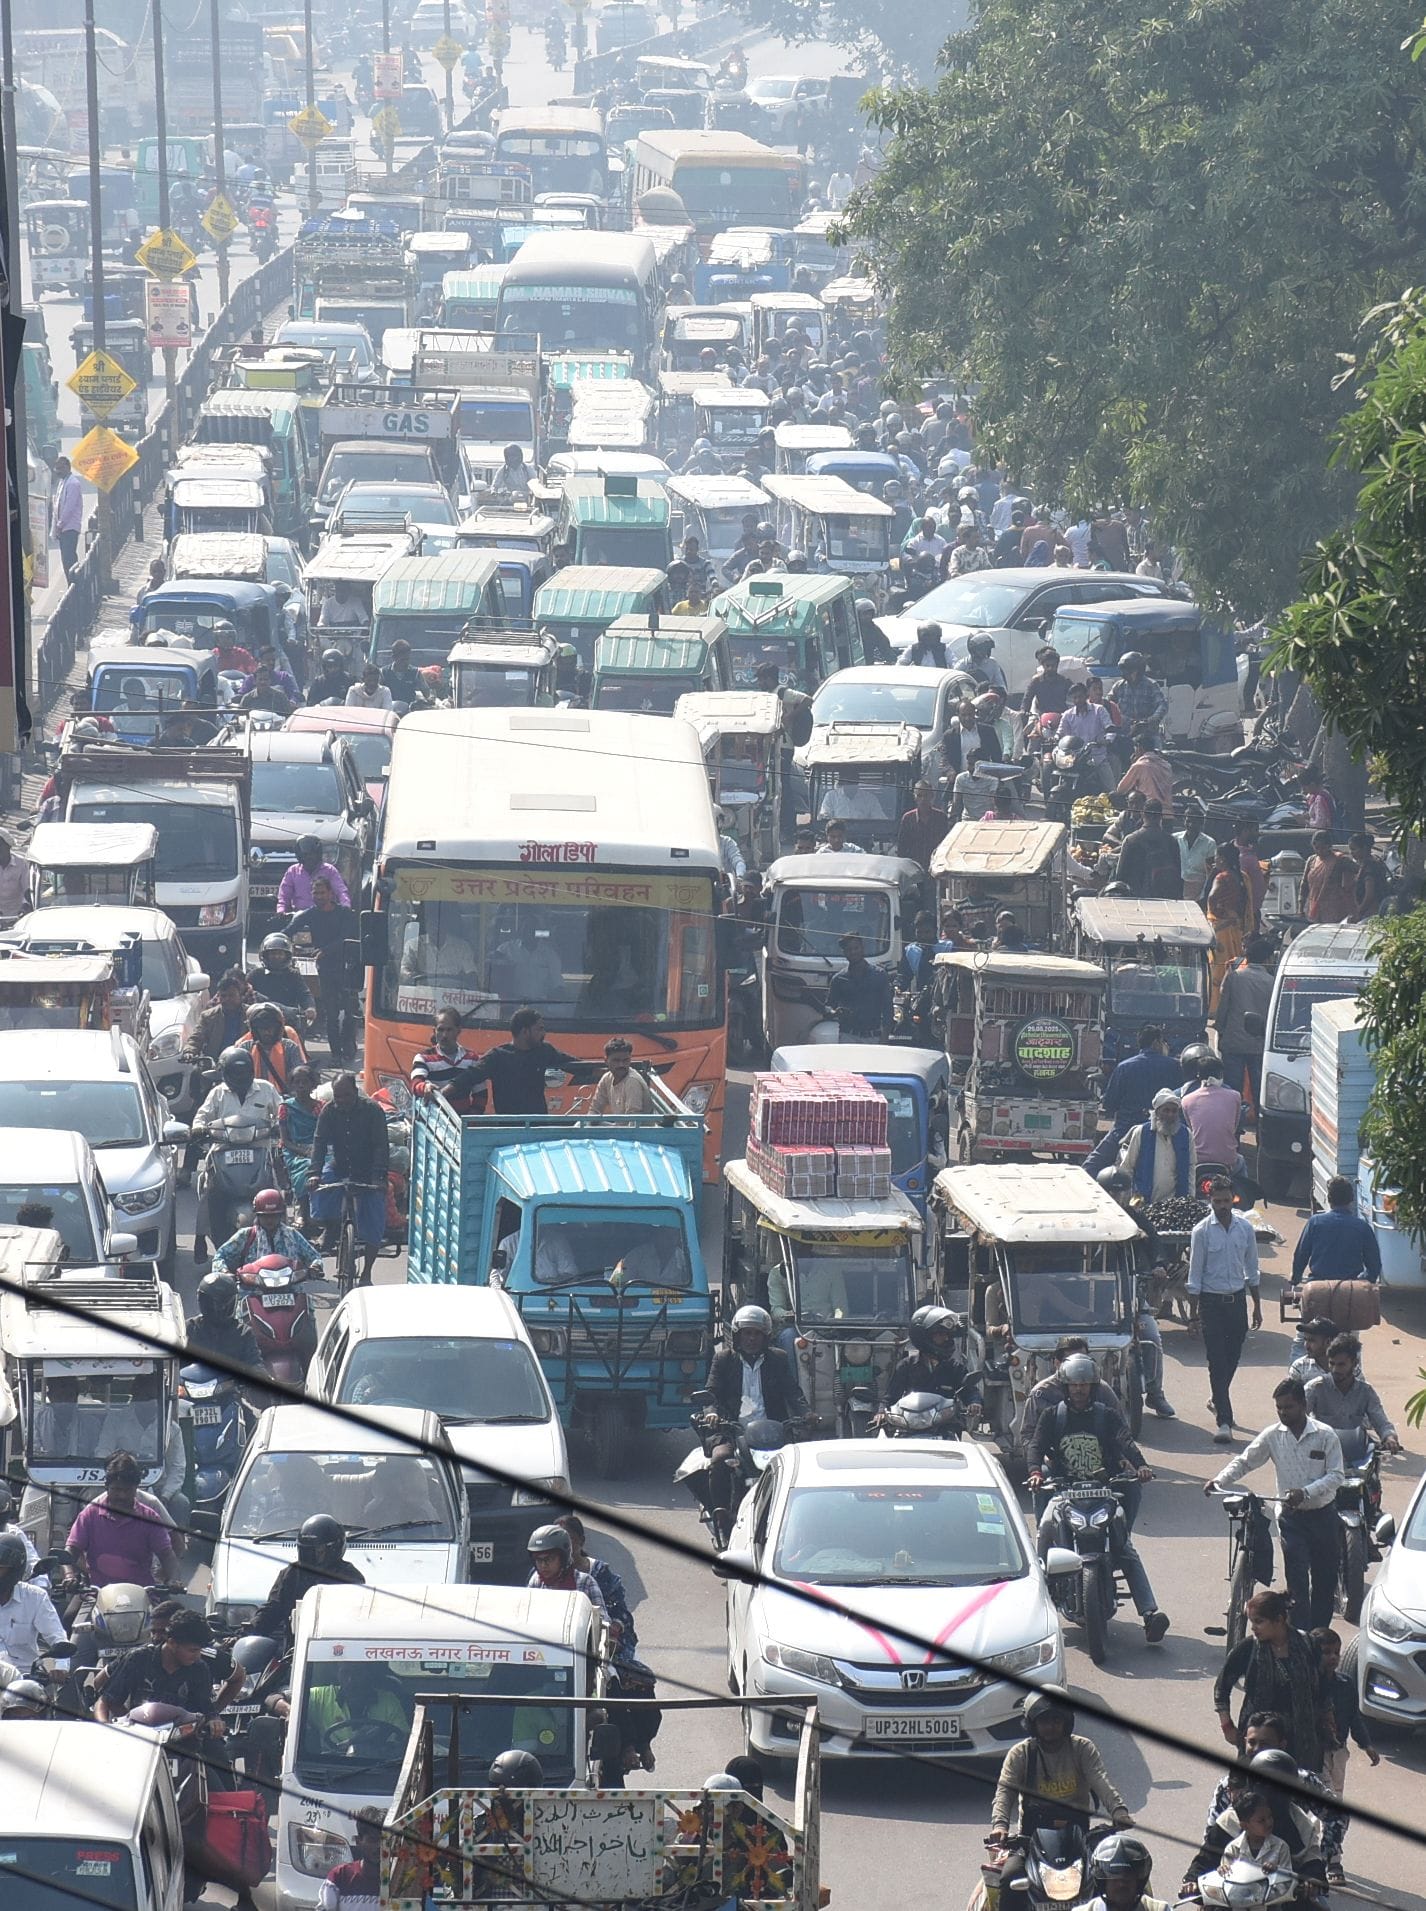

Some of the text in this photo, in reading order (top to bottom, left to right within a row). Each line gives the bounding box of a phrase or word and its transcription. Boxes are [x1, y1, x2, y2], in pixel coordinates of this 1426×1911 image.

[382, 412, 430, 433] GAS
[450, 873, 652, 901] उत्तर प्रदेश परिवहन
[364, 1644, 511, 1662] लखनऊ नगर निगम
[522, 1650, 545, 1662] LSA
[875, 1719, 958, 1735] UP32HL5005
